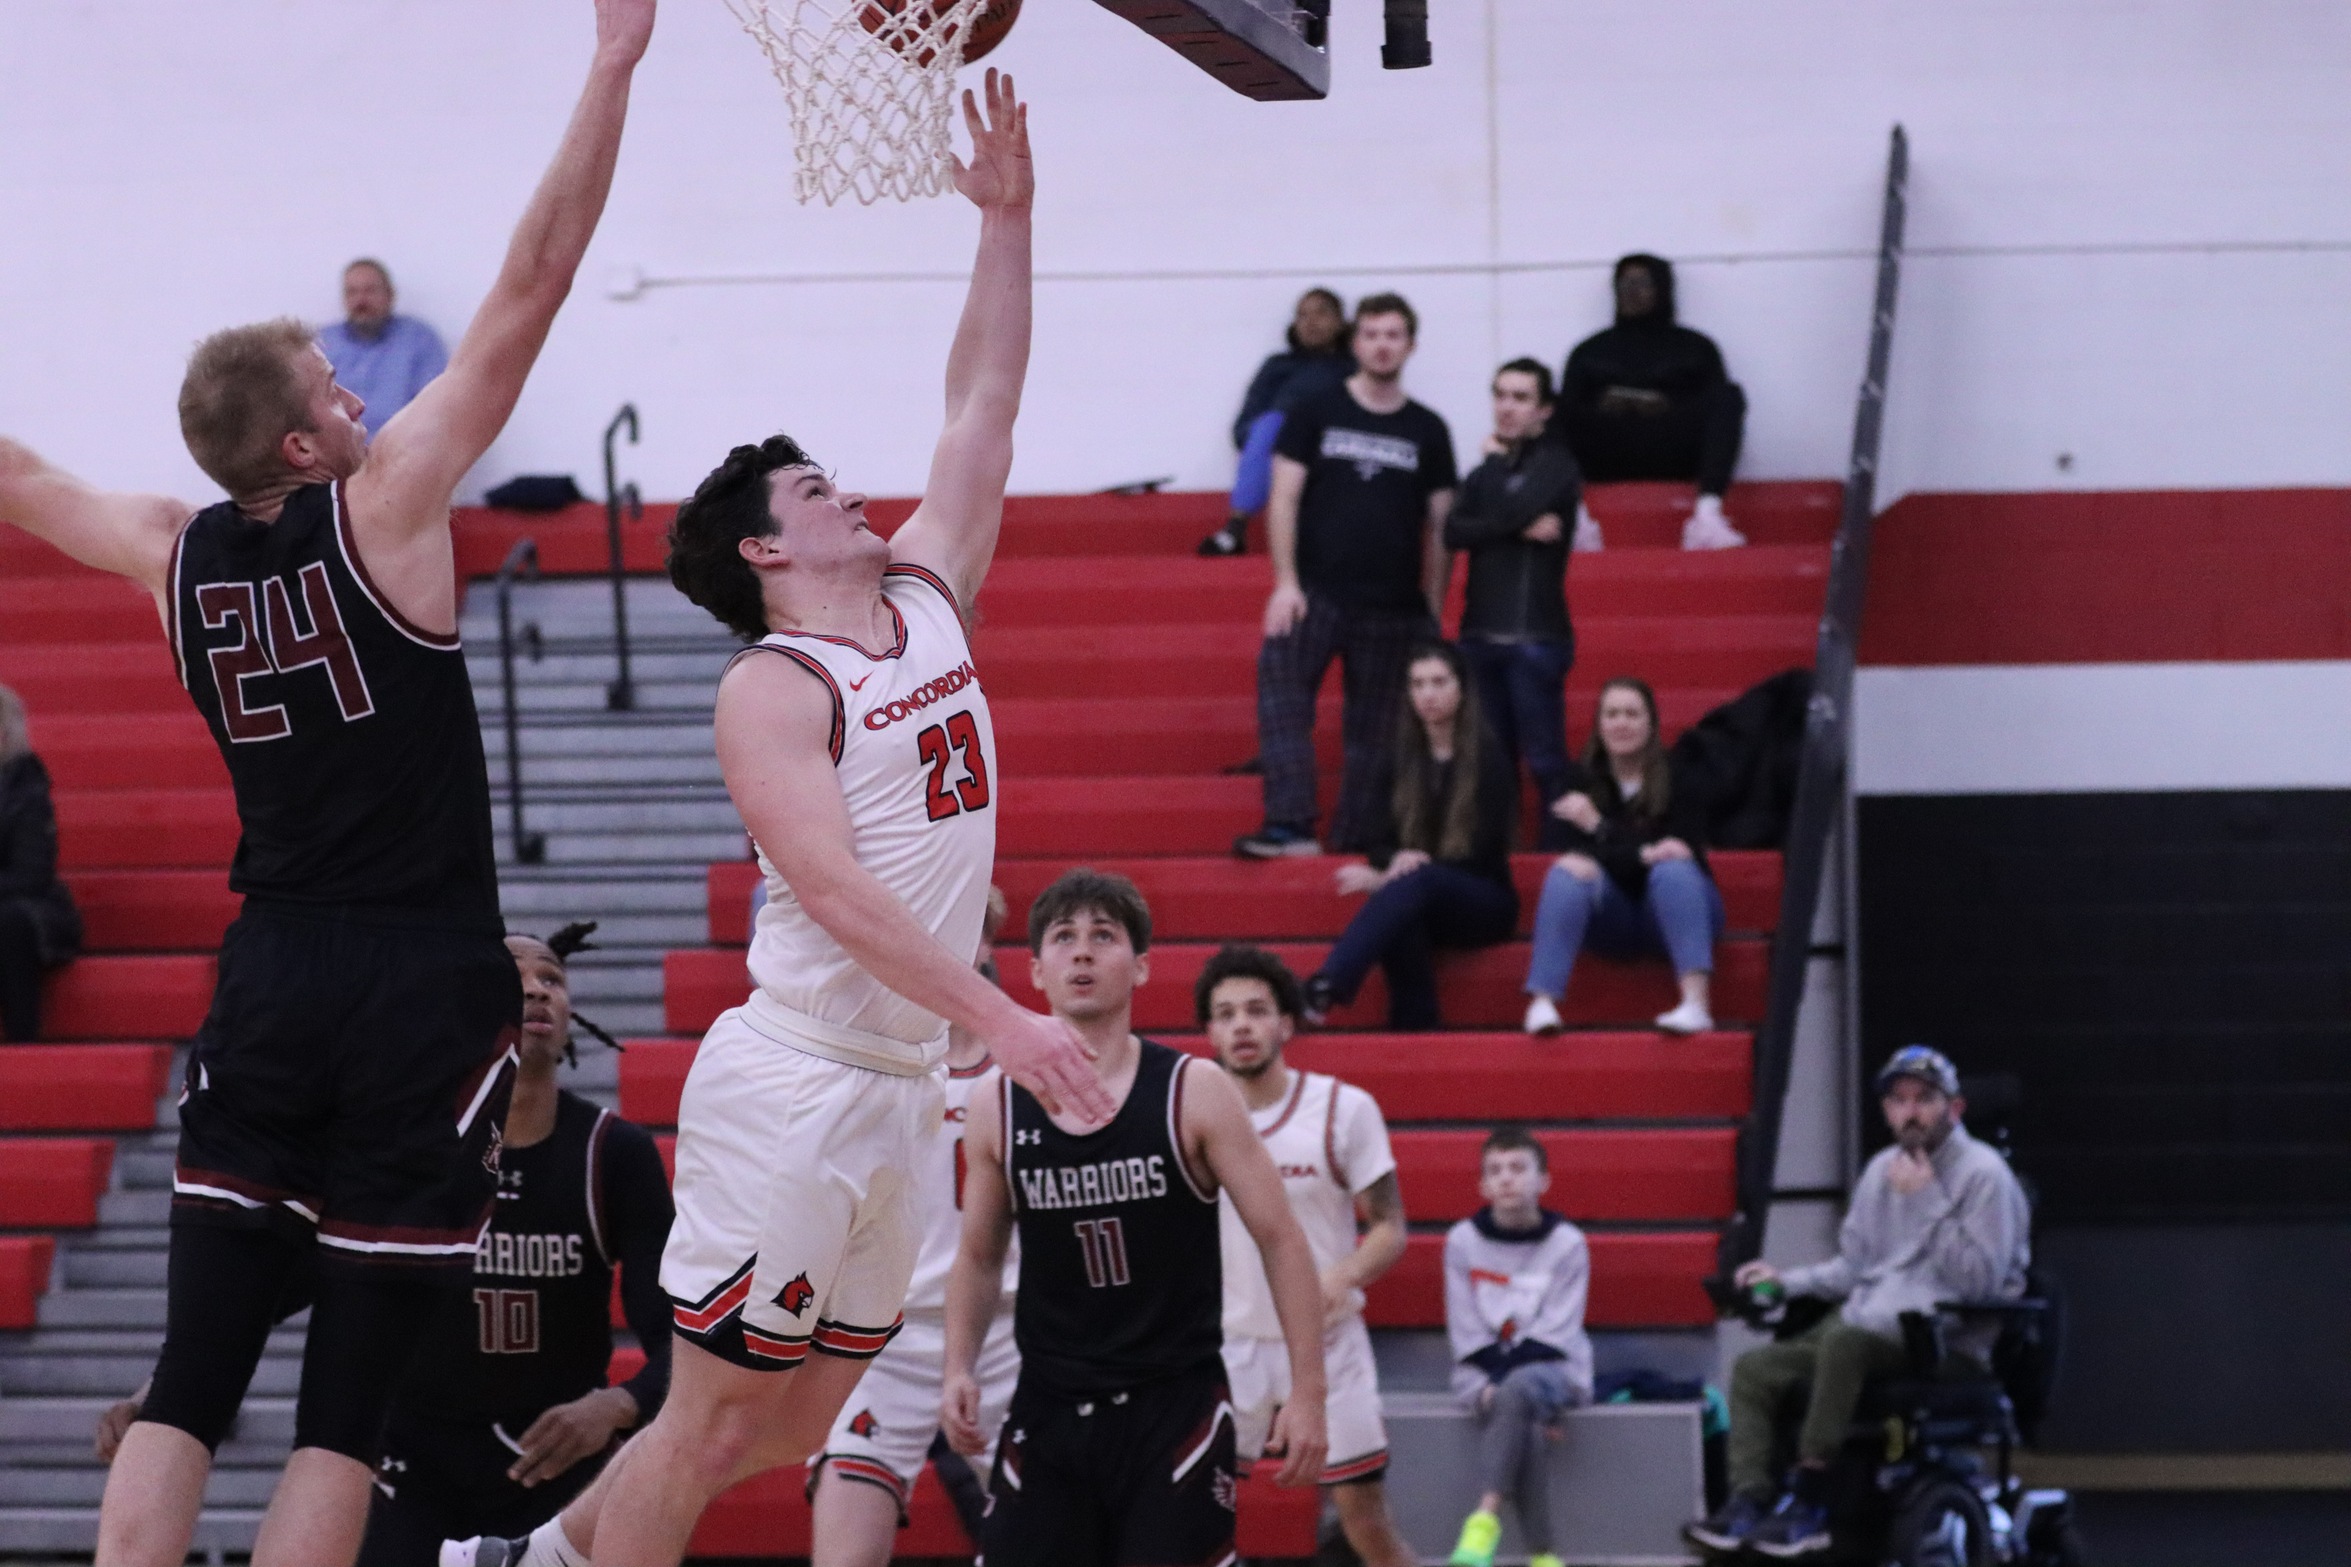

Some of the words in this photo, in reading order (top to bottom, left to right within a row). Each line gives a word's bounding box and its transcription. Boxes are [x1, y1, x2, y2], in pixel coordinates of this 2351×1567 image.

[196, 559, 376, 743] 24
[863, 660, 978, 730] CONCORDIA
[917, 709, 989, 822] 23
[1019, 1155, 1167, 1210] WARRIORS
[474, 1232, 583, 1277] RRIORS
[1074, 1216, 1131, 1288] 11
[473, 1288, 540, 1354] 10
